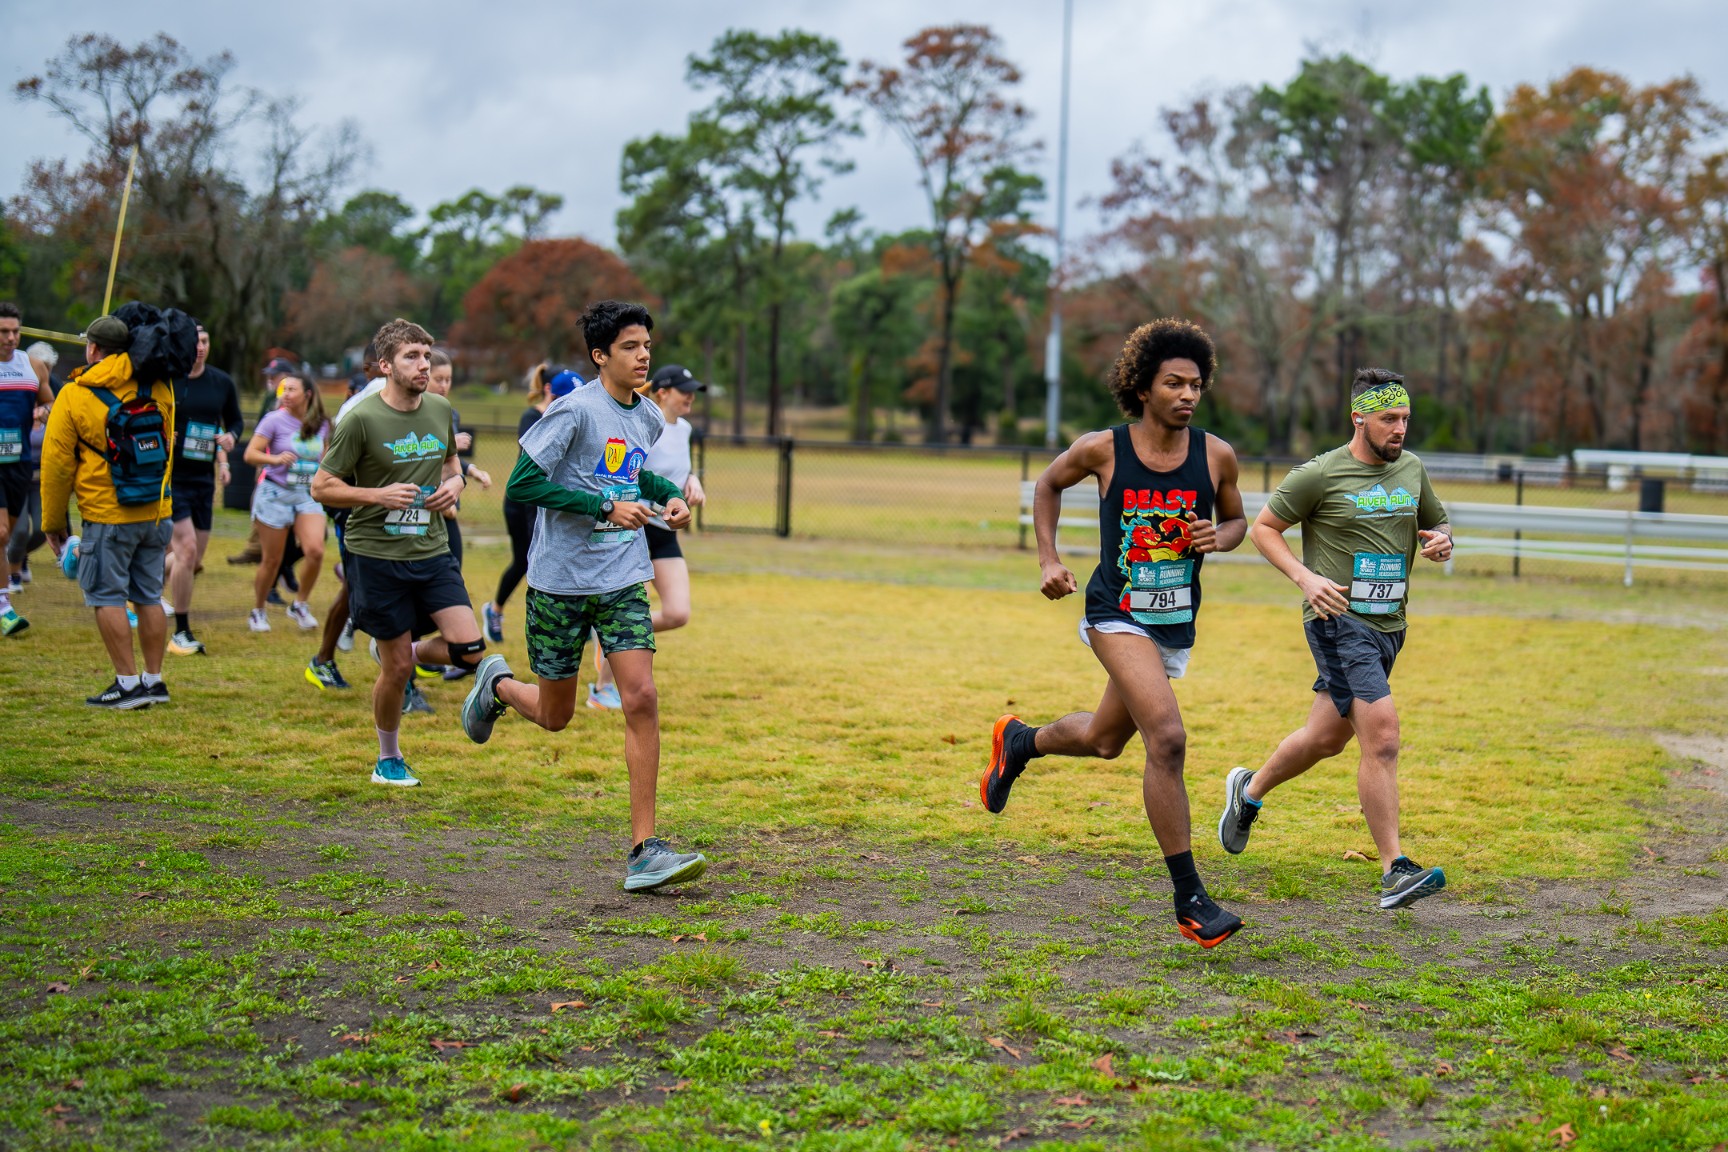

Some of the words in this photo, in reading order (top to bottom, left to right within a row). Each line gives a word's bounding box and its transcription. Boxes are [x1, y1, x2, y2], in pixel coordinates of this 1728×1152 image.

[394, 443, 419, 456] RIVER
[420, 439, 440, 452] RUN
[1123, 489, 1197, 517] BEAST
[1357, 496, 1387, 507] RIVER
[1390, 493, 1411, 506] RUN
[399, 509, 419, 522] 724
[1368, 583, 1394, 598] 737
[1149, 591, 1176, 608] 794
